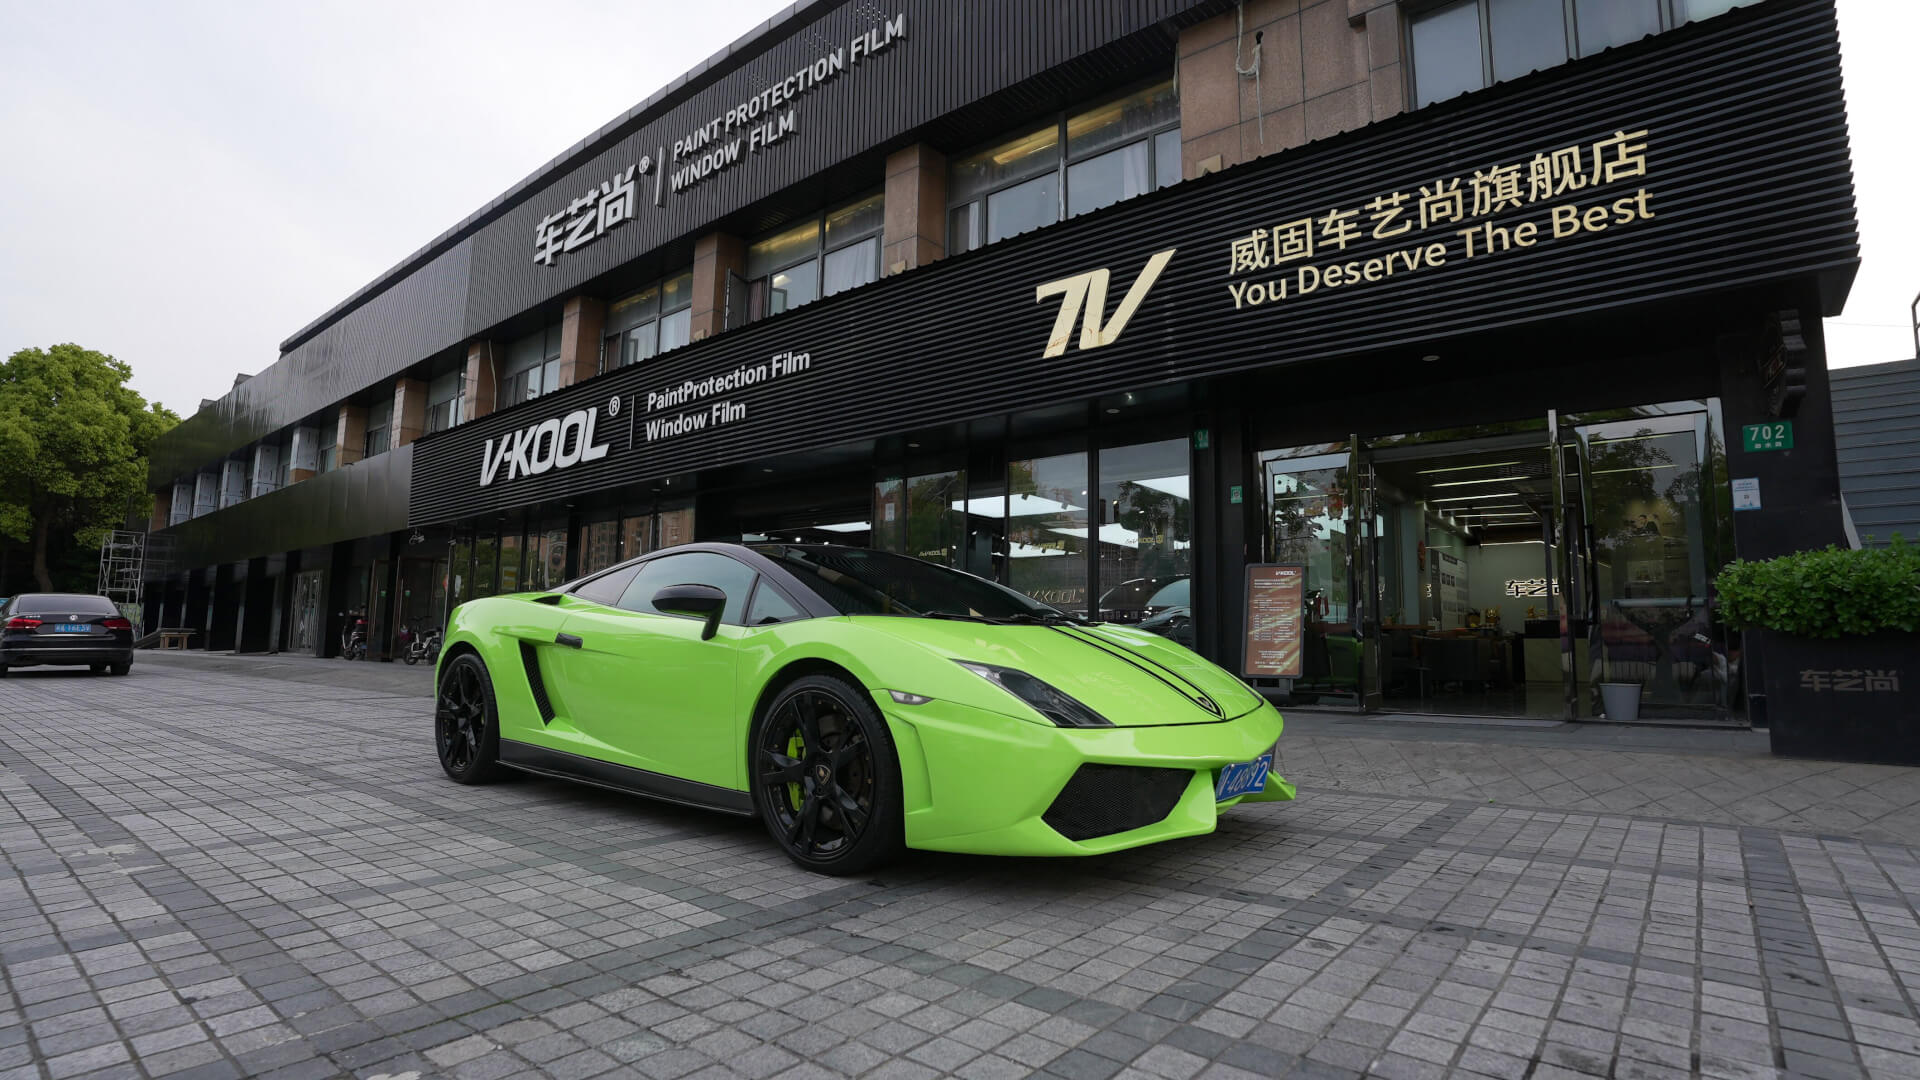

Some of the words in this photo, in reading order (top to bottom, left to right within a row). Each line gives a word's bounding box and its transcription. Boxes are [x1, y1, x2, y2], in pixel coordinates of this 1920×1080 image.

[673, 118, 721, 162] PAINT
[725, 48, 843, 132] PROTECTION
[850, 14, 903, 64] FILM
[671, 138, 740, 194] WINDOW
[750, 110, 795, 152] FILM
[534, 165, 637, 266] 车艺尚
[1229, 129, 1649, 276] 威固车艺尚旗舰店
[1229, 268, 1288, 309] You
[1299, 240, 1447, 292] Deserve
[1457, 212, 1538, 258] The
[1552, 187, 1655, 239] Best
[772, 351, 811, 378] Film
[480, 407, 609, 486] V-KOOL
[646, 411, 707, 442] Window
[712, 402, 746, 426] Film
[1750, 425, 1784, 441] 702
[1800, 669, 1900, 692] 车艺尚
